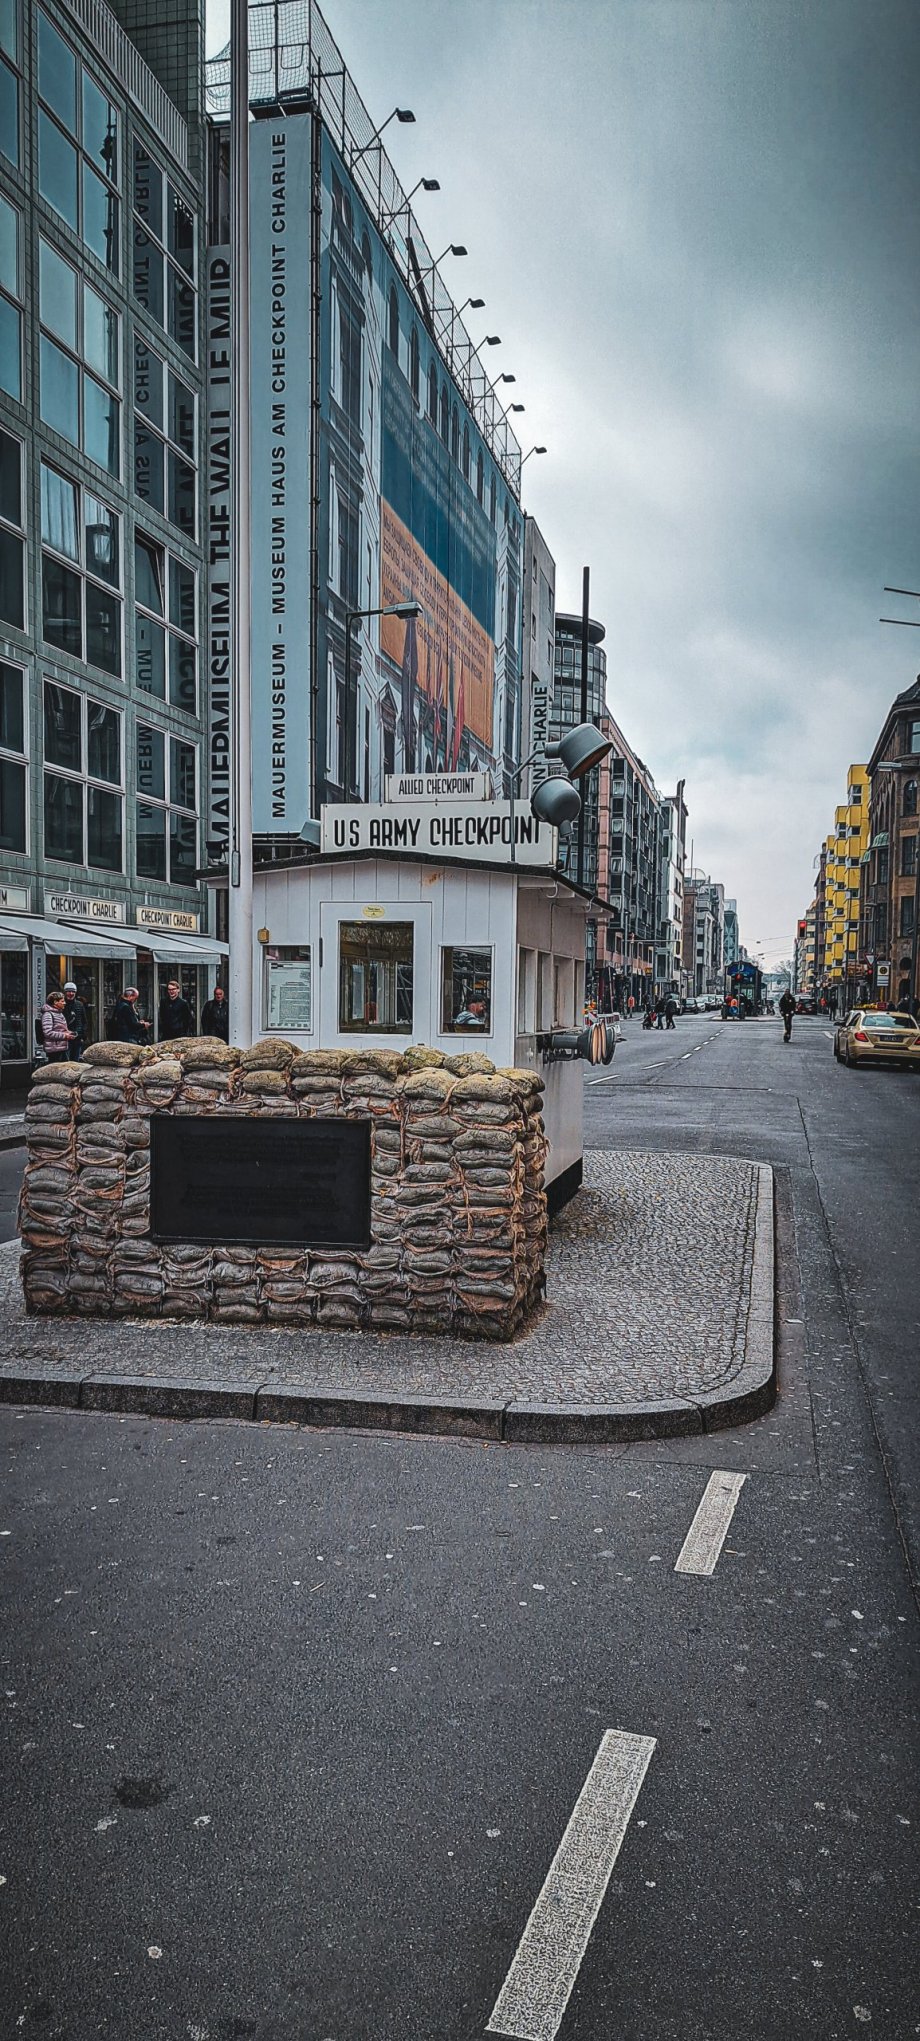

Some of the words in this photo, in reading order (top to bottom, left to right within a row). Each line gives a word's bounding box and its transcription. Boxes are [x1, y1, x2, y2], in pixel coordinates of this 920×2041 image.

[271, 132, 286, 233] CHARLIE
[271, 244, 286, 393] CHECKPOINT
[271, 403, 286, 436] AM
[271, 445, 286, 507] HAUS
[210, 505, 230, 565] THE
[271, 517, 286, 614] MUSEUM
[271, 643, 286, 818] MAUERMUSEUM
[533, 687, 548, 754] CHARLIE
[399, 779, 424, 795] ALLIED
[426, 777, 475, 794] CHECKPOINT
[370, 818, 421, 846] ARMY
[430, 816, 541, 846] CHECKPOINT
[51, 896, 91, 917] CHECKPOINT
[92, 902, 117, 919] CHARLIE
[141, 908, 173, 926] CHECKPOINT
[173, 915, 193, 929] CHARLIE
